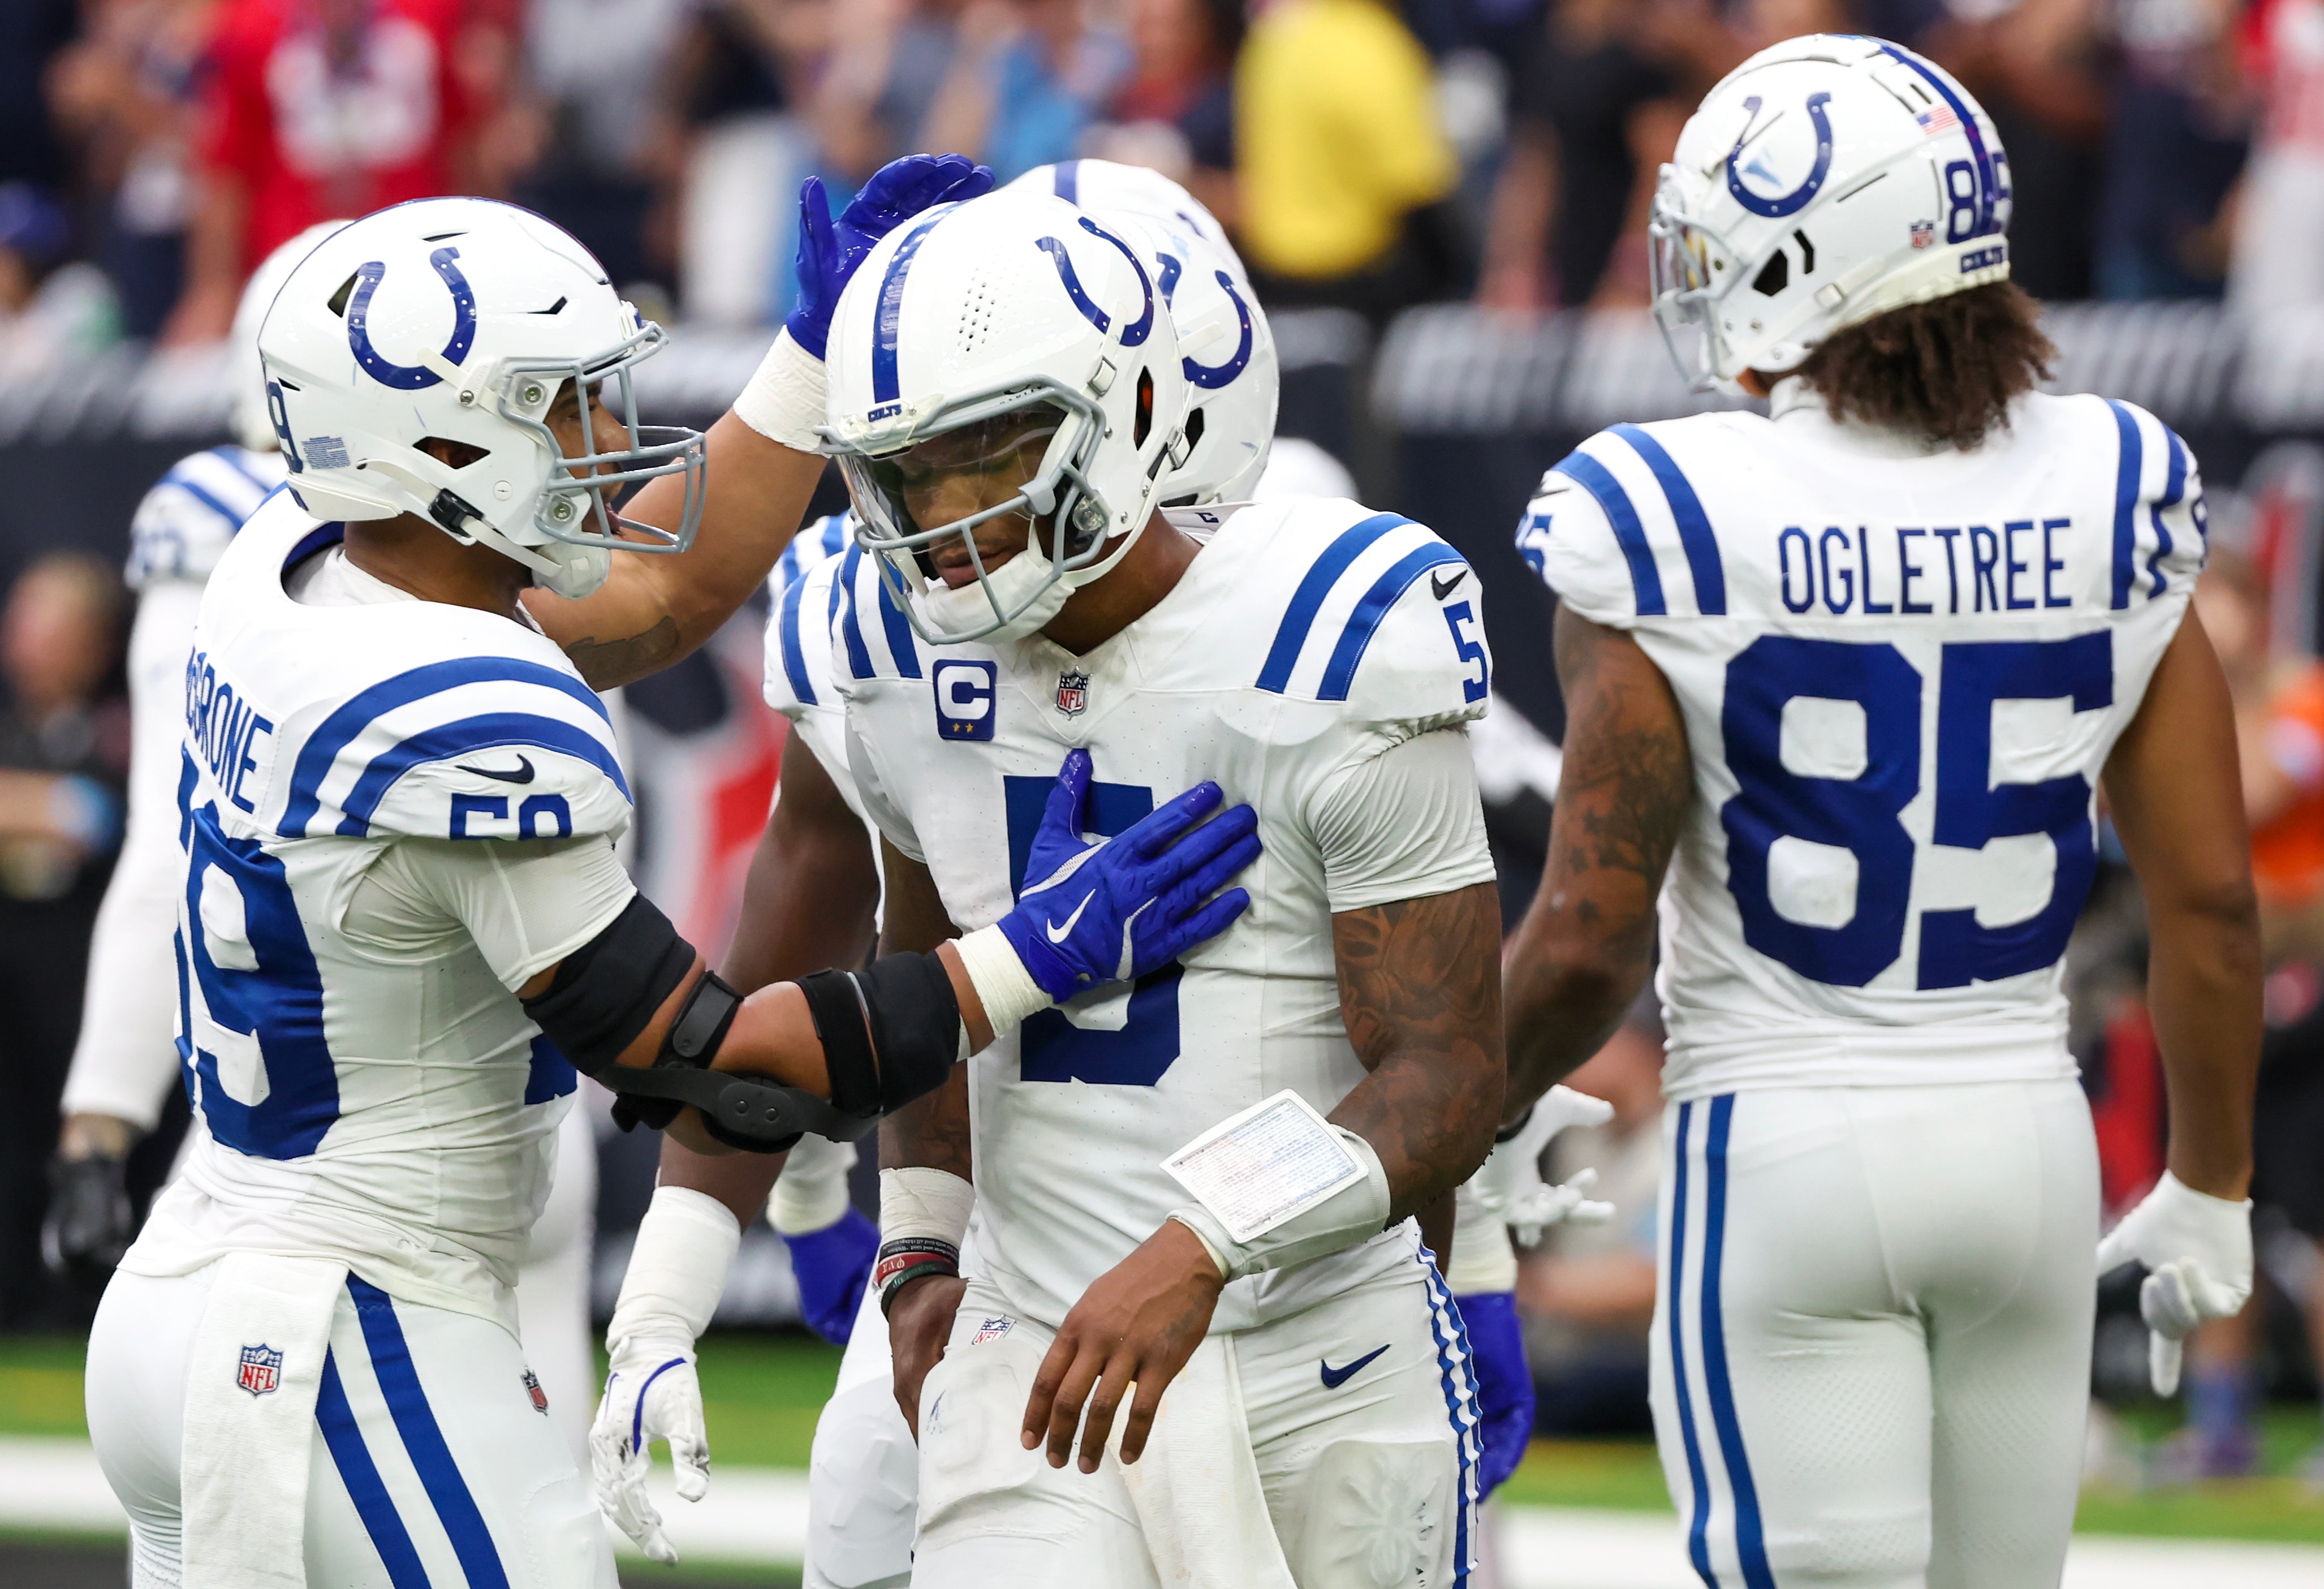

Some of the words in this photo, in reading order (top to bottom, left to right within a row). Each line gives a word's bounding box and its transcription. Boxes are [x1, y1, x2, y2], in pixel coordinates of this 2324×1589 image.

[1779, 518, 2072, 615] OGLETREE
[1443, 600, 1488, 704] 5
[937, 666, 990, 720] C
[1059, 690, 1082, 709] NFL
[1721, 629, 2114, 991] 85
[241, 1364, 274, 1392] NFL
